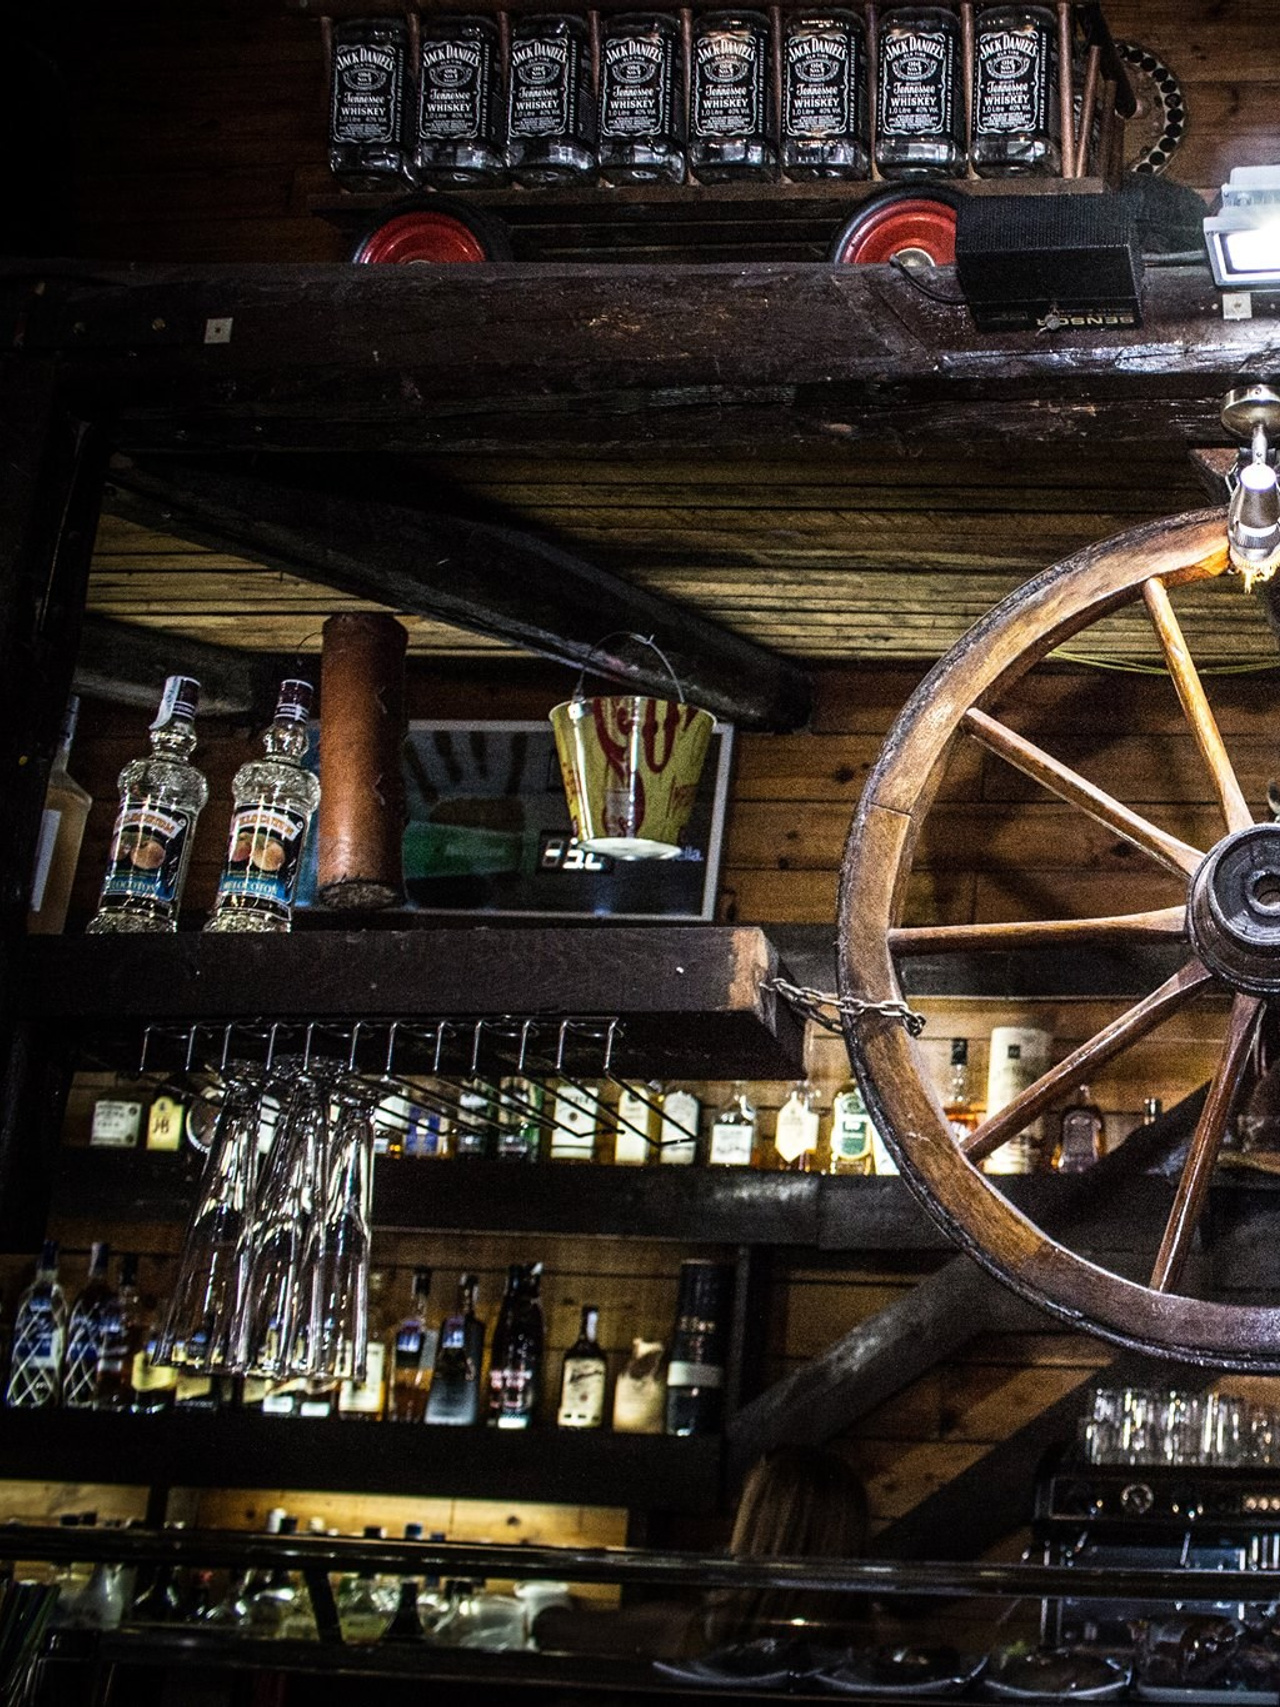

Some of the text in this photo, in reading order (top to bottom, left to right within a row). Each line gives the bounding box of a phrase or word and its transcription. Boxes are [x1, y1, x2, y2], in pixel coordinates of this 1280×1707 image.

[606, 40, 665, 65] JACK DANIEL'S
[698, 39, 757, 64] JACK DANIEL'S
[789, 37, 849, 63] JACK DANIEL'S
[886, 36, 946, 61] JACK DANIEL'S
[980, 34, 1039, 60] JACK DANIEL'S
[337, 48, 396, 71] JACK DANIEL'S
[423, 44, 482, 68] JACK DANIEL'S
[512, 41, 569, 67] JACK DANIEL'S
[518, 86, 558, 99] Tennessee
[612, 85, 654, 98] Tennessee
[705, 84, 747, 97] Tennessee
[796, 83, 838, 96] Tennessee
[893, 82, 935, 95] Tennessee
[987, 81, 1028, 93] Tennessee
[343, 92, 385, 105] Tennessee
[429, 89, 471, 101] Tennessee
[891, 96, 937, 107] WHISKEY
[985, 94, 1030, 105] WHISKEY
[427, 102, 472, 113] WHISKEY
[516, 99, 560, 110] WHISKEY
[610, 98, 655, 109] WHISKEY
[703, 98, 749, 109] WHISKEY
[794, 97, 840, 108] WHISKEY
[341, 105, 386, 117] WHISKEY
